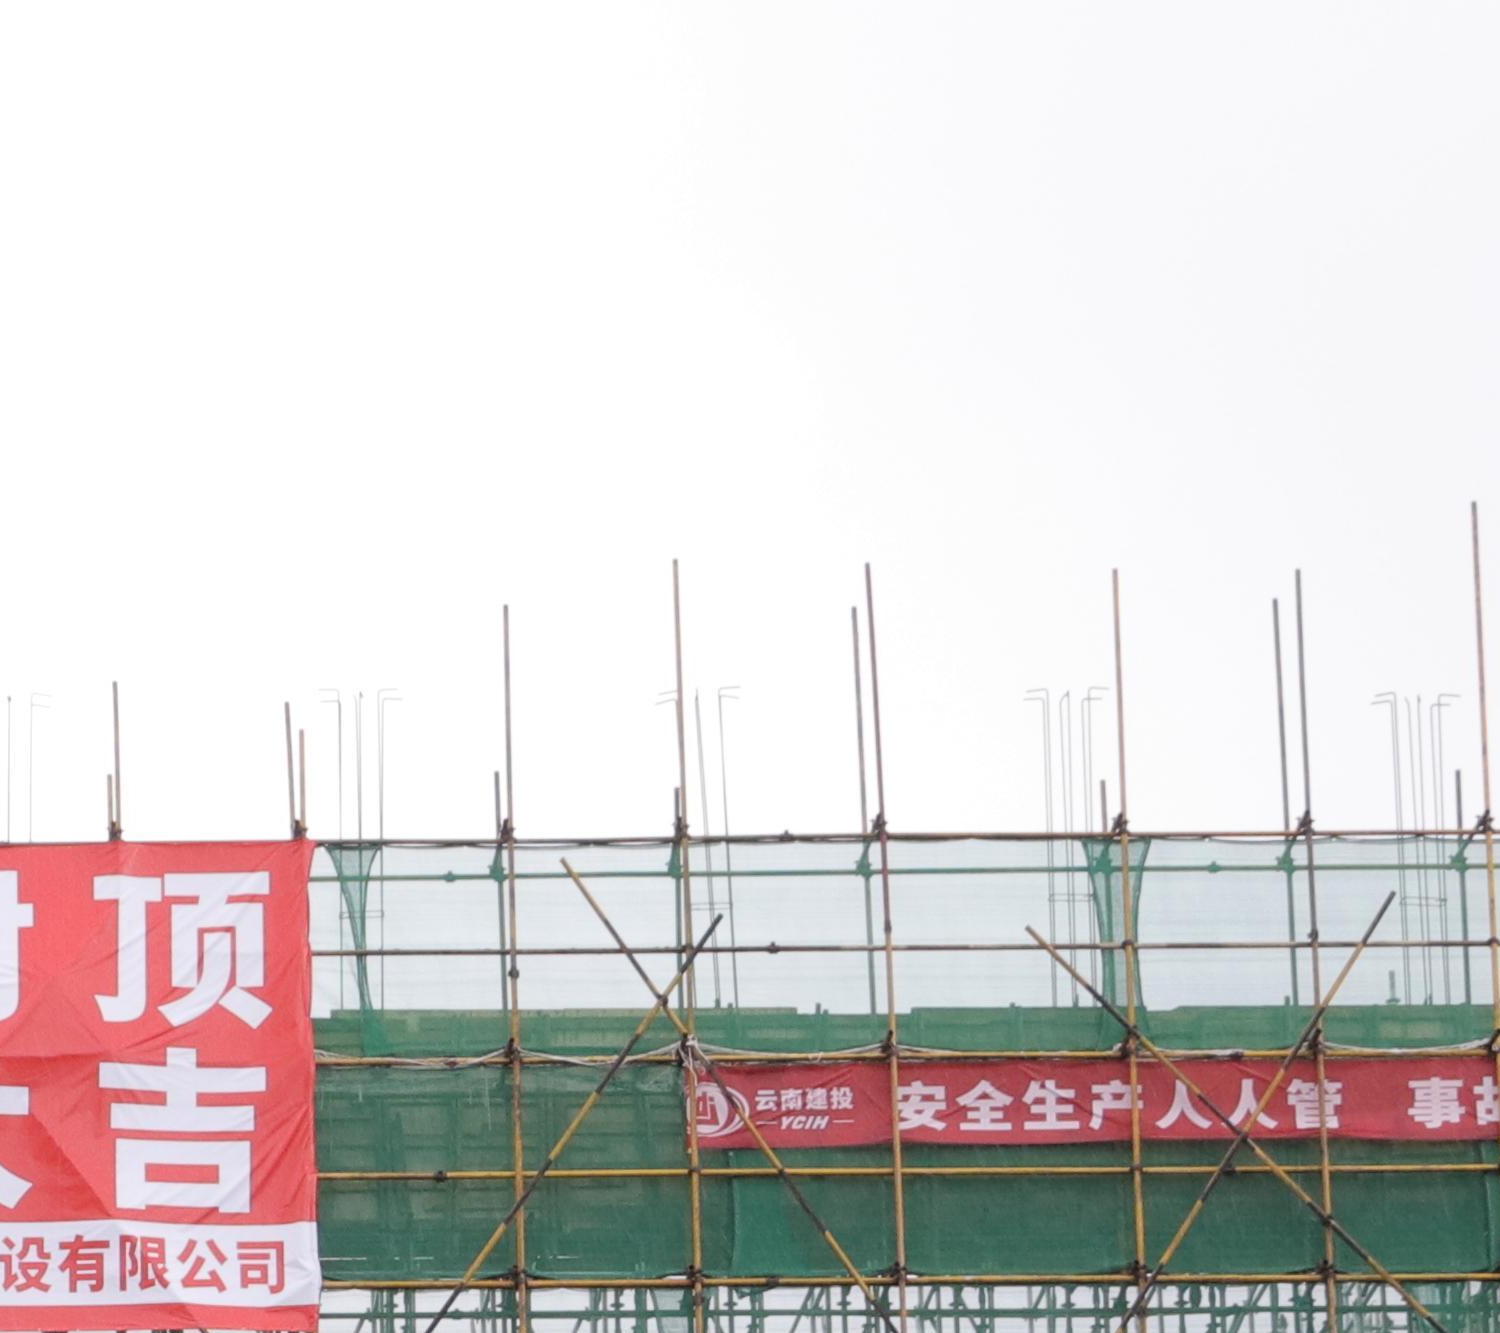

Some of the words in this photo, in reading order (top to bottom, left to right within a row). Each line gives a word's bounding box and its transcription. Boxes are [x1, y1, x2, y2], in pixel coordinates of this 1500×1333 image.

[755, 1087, 854, 1111] 云南建投
[896, 1078, 1343, 1132] 安全生产人人管
[780, 1116, 829, 1130] YCIH
